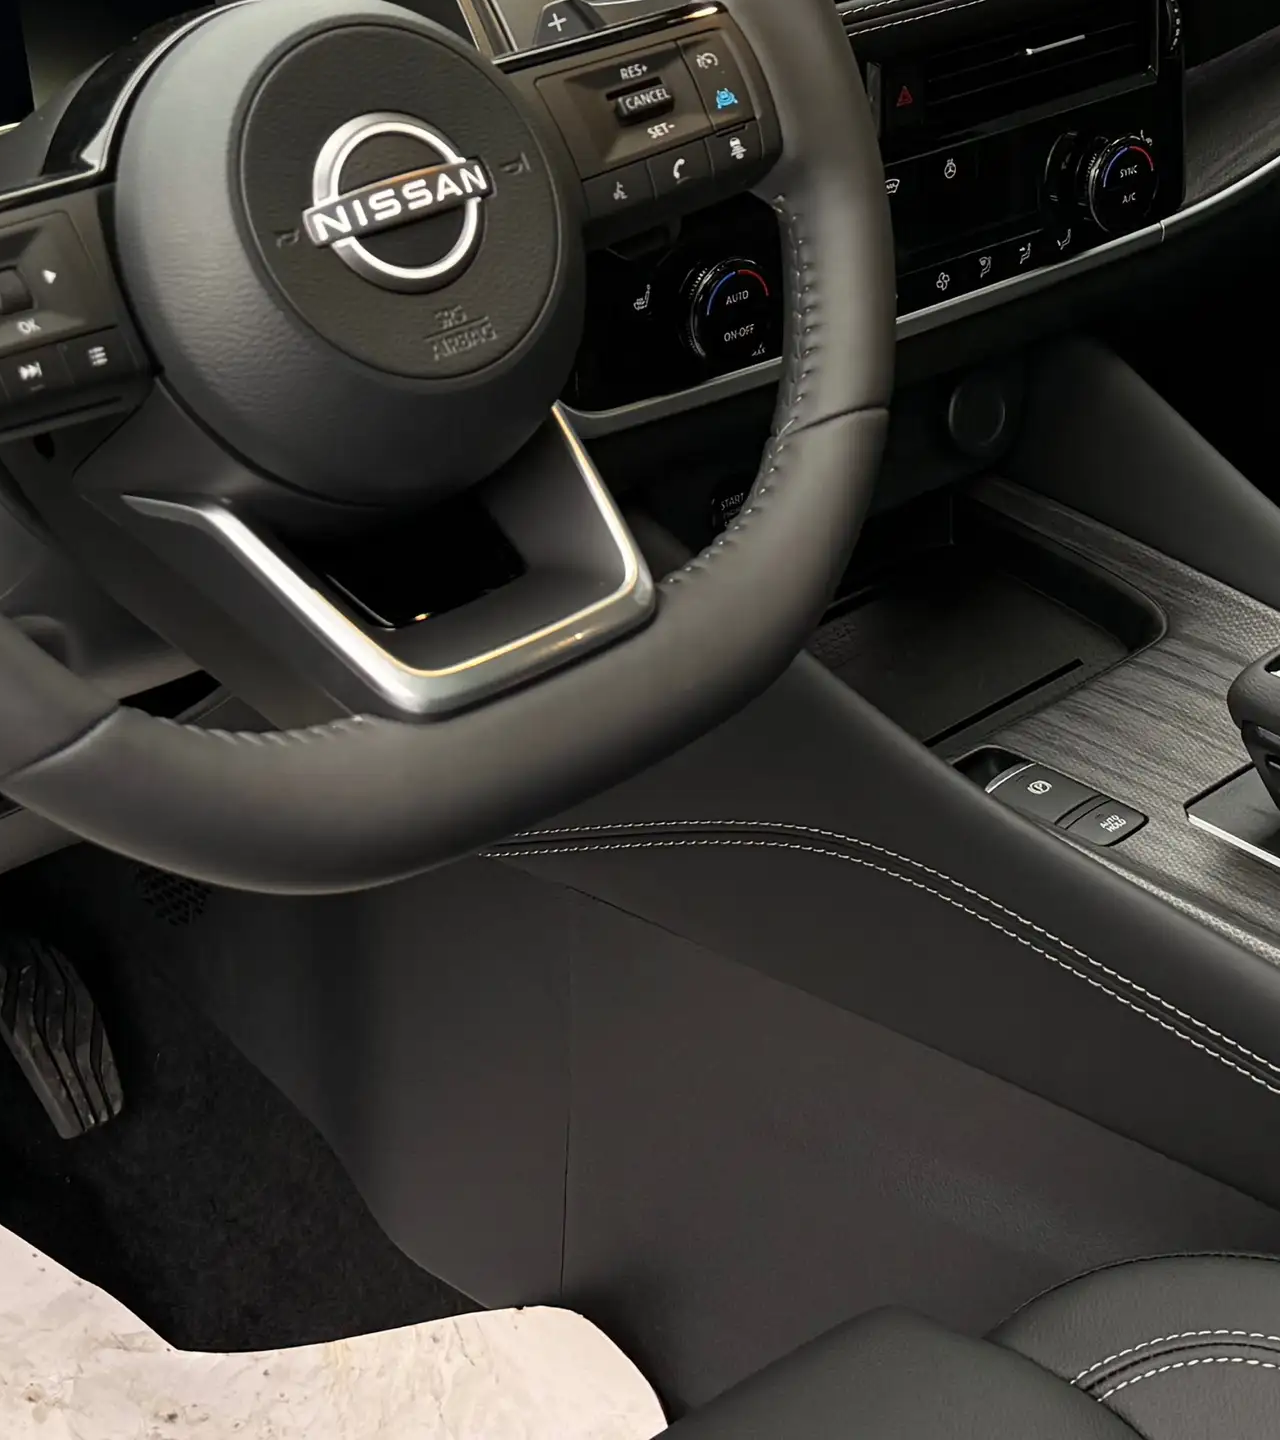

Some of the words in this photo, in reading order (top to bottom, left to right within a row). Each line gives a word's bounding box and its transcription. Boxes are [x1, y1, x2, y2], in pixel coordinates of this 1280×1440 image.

[625, 87, 671, 111] CANCEL
[312, 165, 488, 242] NISSAN
[1122, 192, 1136, 204] A/C
[726, 290, 749, 305] AUTO
[17, 318, 41, 334] OK
[433, 322, 498, 361] AIRBAG
